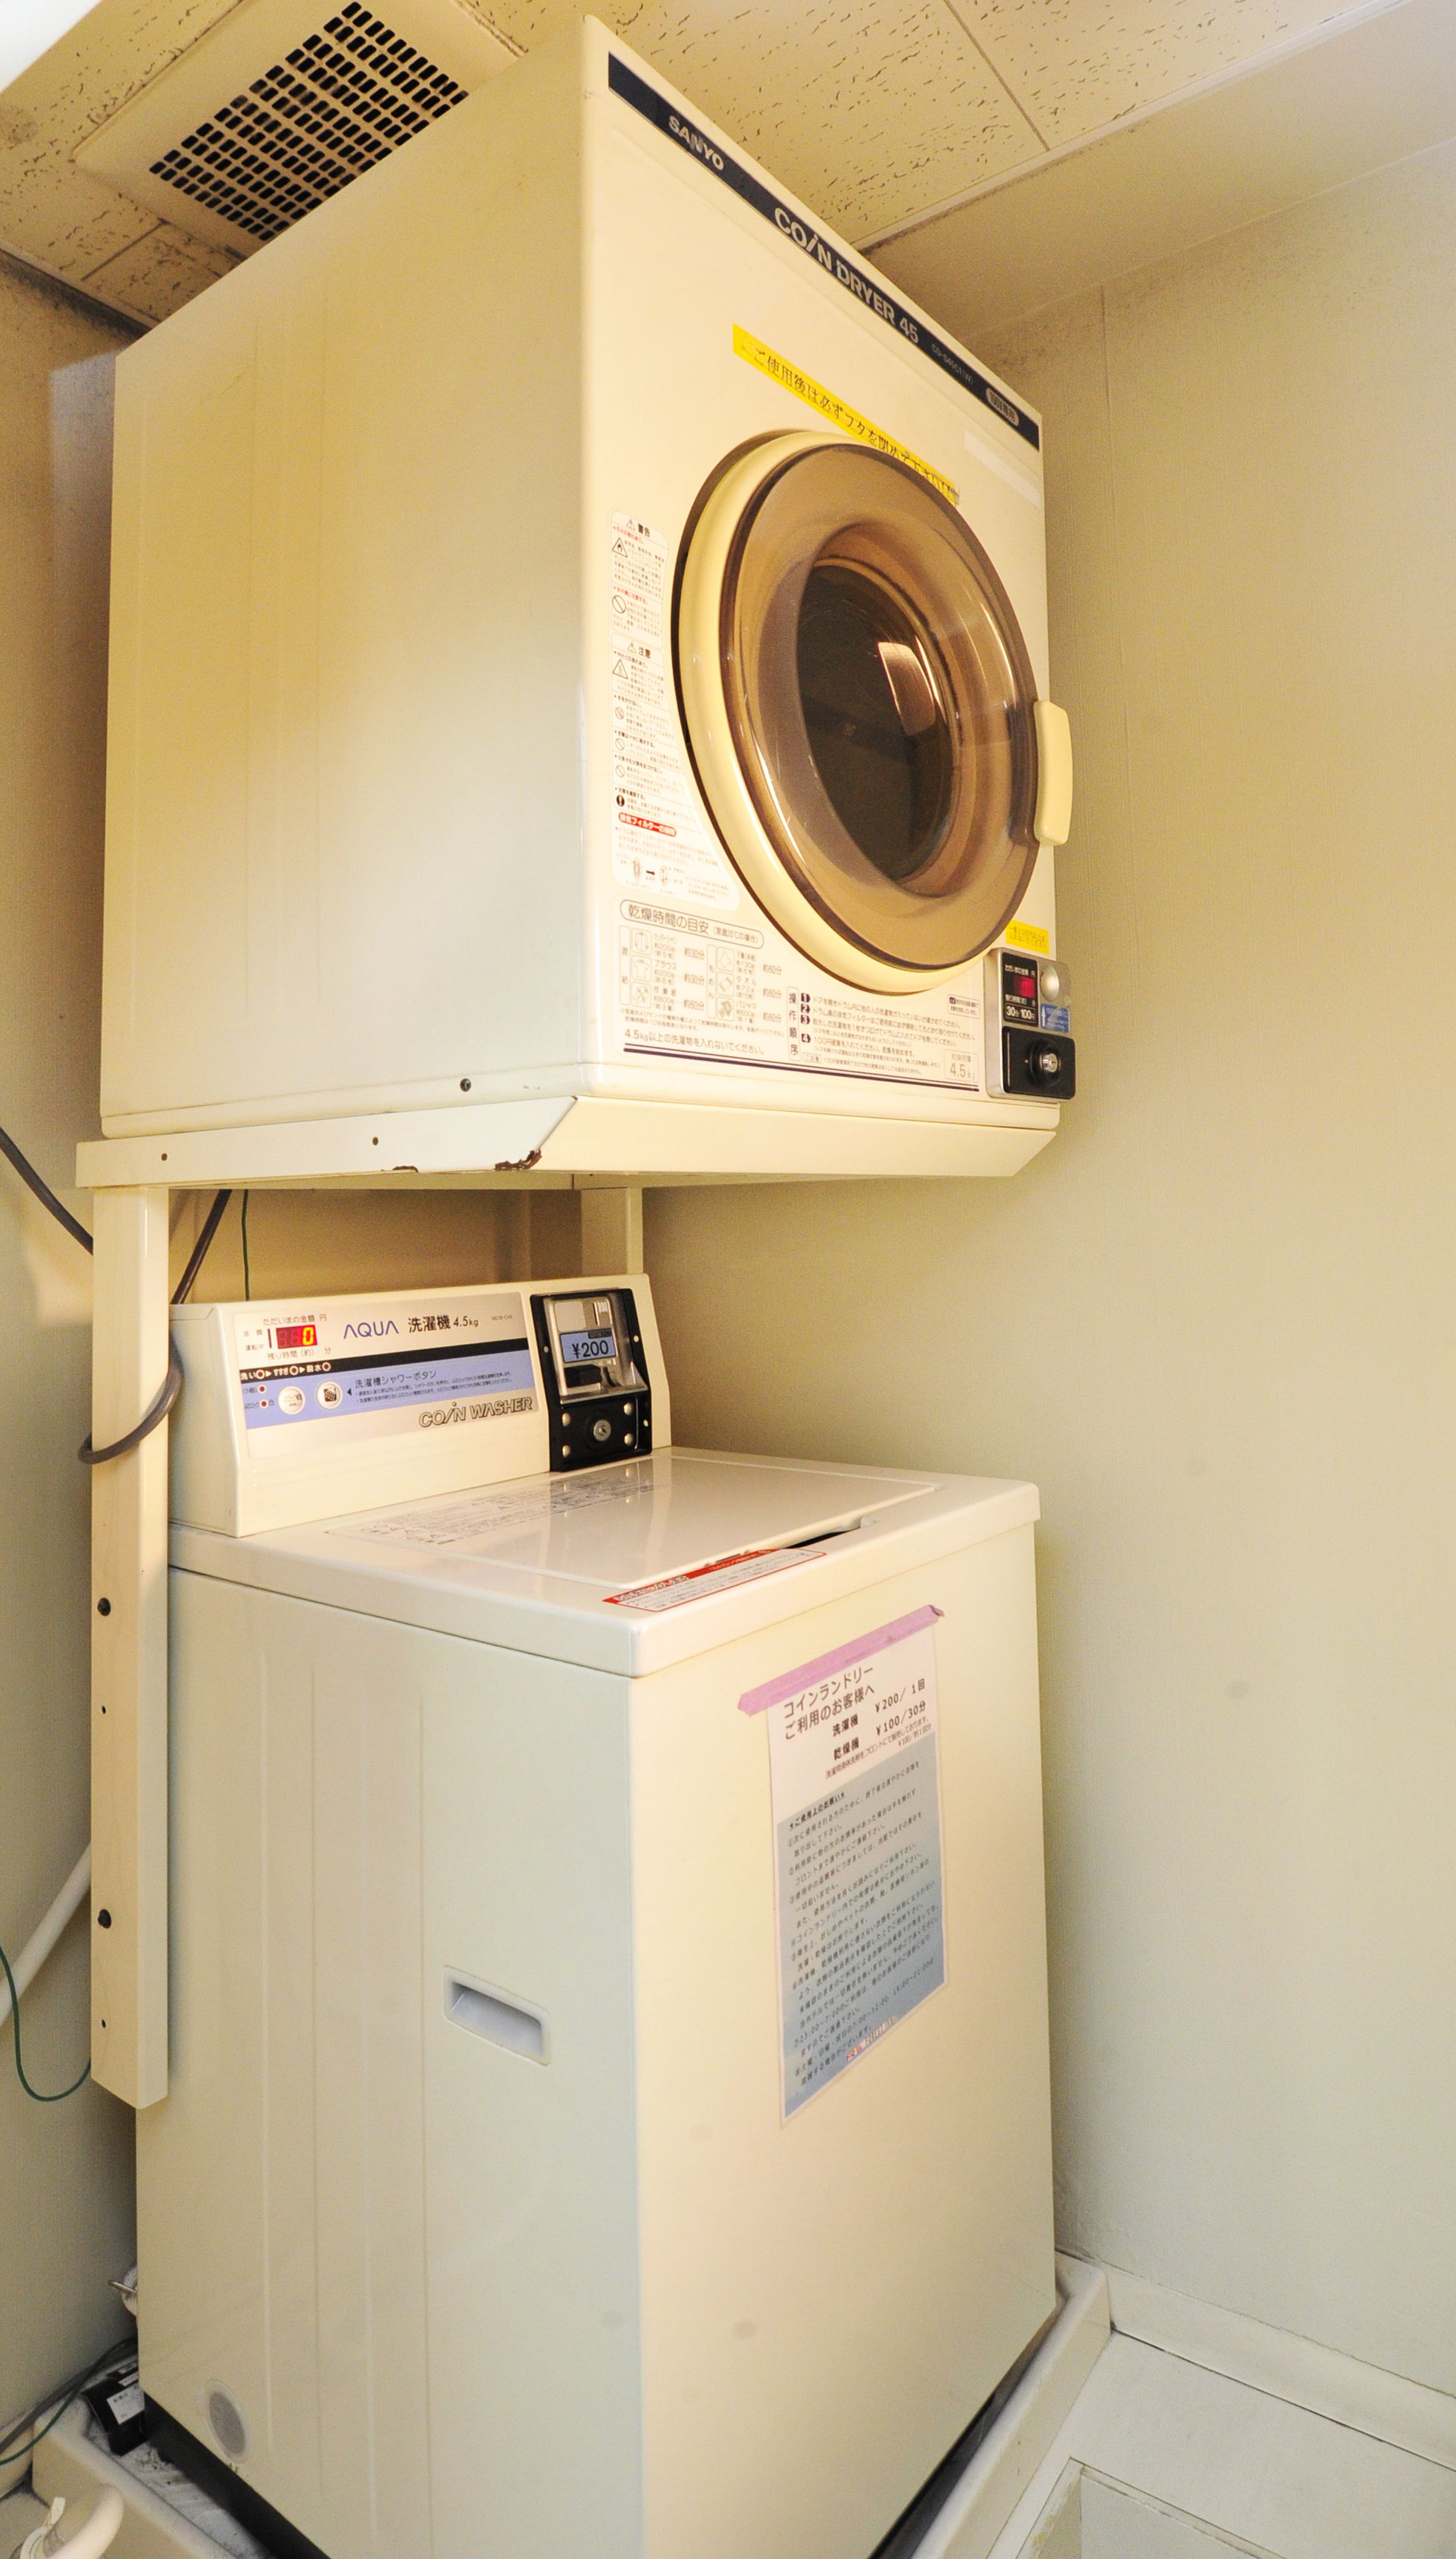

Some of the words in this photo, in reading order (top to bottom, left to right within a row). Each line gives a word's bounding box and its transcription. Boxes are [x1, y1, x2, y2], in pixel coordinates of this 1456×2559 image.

[668, 115, 724, 171] SANYO
[774, 207, 832, 271] COIN
[836, 260, 895, 325] DRYER
[900, 317, 918, 344] 45
[628, 904, 709, 935] 乾燥時間の目安
[263, 1315, 315, 1325] ただいまの金額
[341, 1319, 399, 1339] AQUA
[407, 1314, 451, 1333] 洗濯機
[452, 1315, 478, 1329] 4.5kg
[572, 1340, 609, 1358] ¥200
[354, 1369, 437, 1388] 洗濯槽シャワーボタン
[470, 1396, 533, 1421] WASHER
[784, 1661, 873, 1719] コインランドリー
[784, 1681, 874, 1741] ご利用のお客様へ
[832, 1713, 858, 1738] 洗濯機
[834, 1736, 859, 1761] 乾燥機
